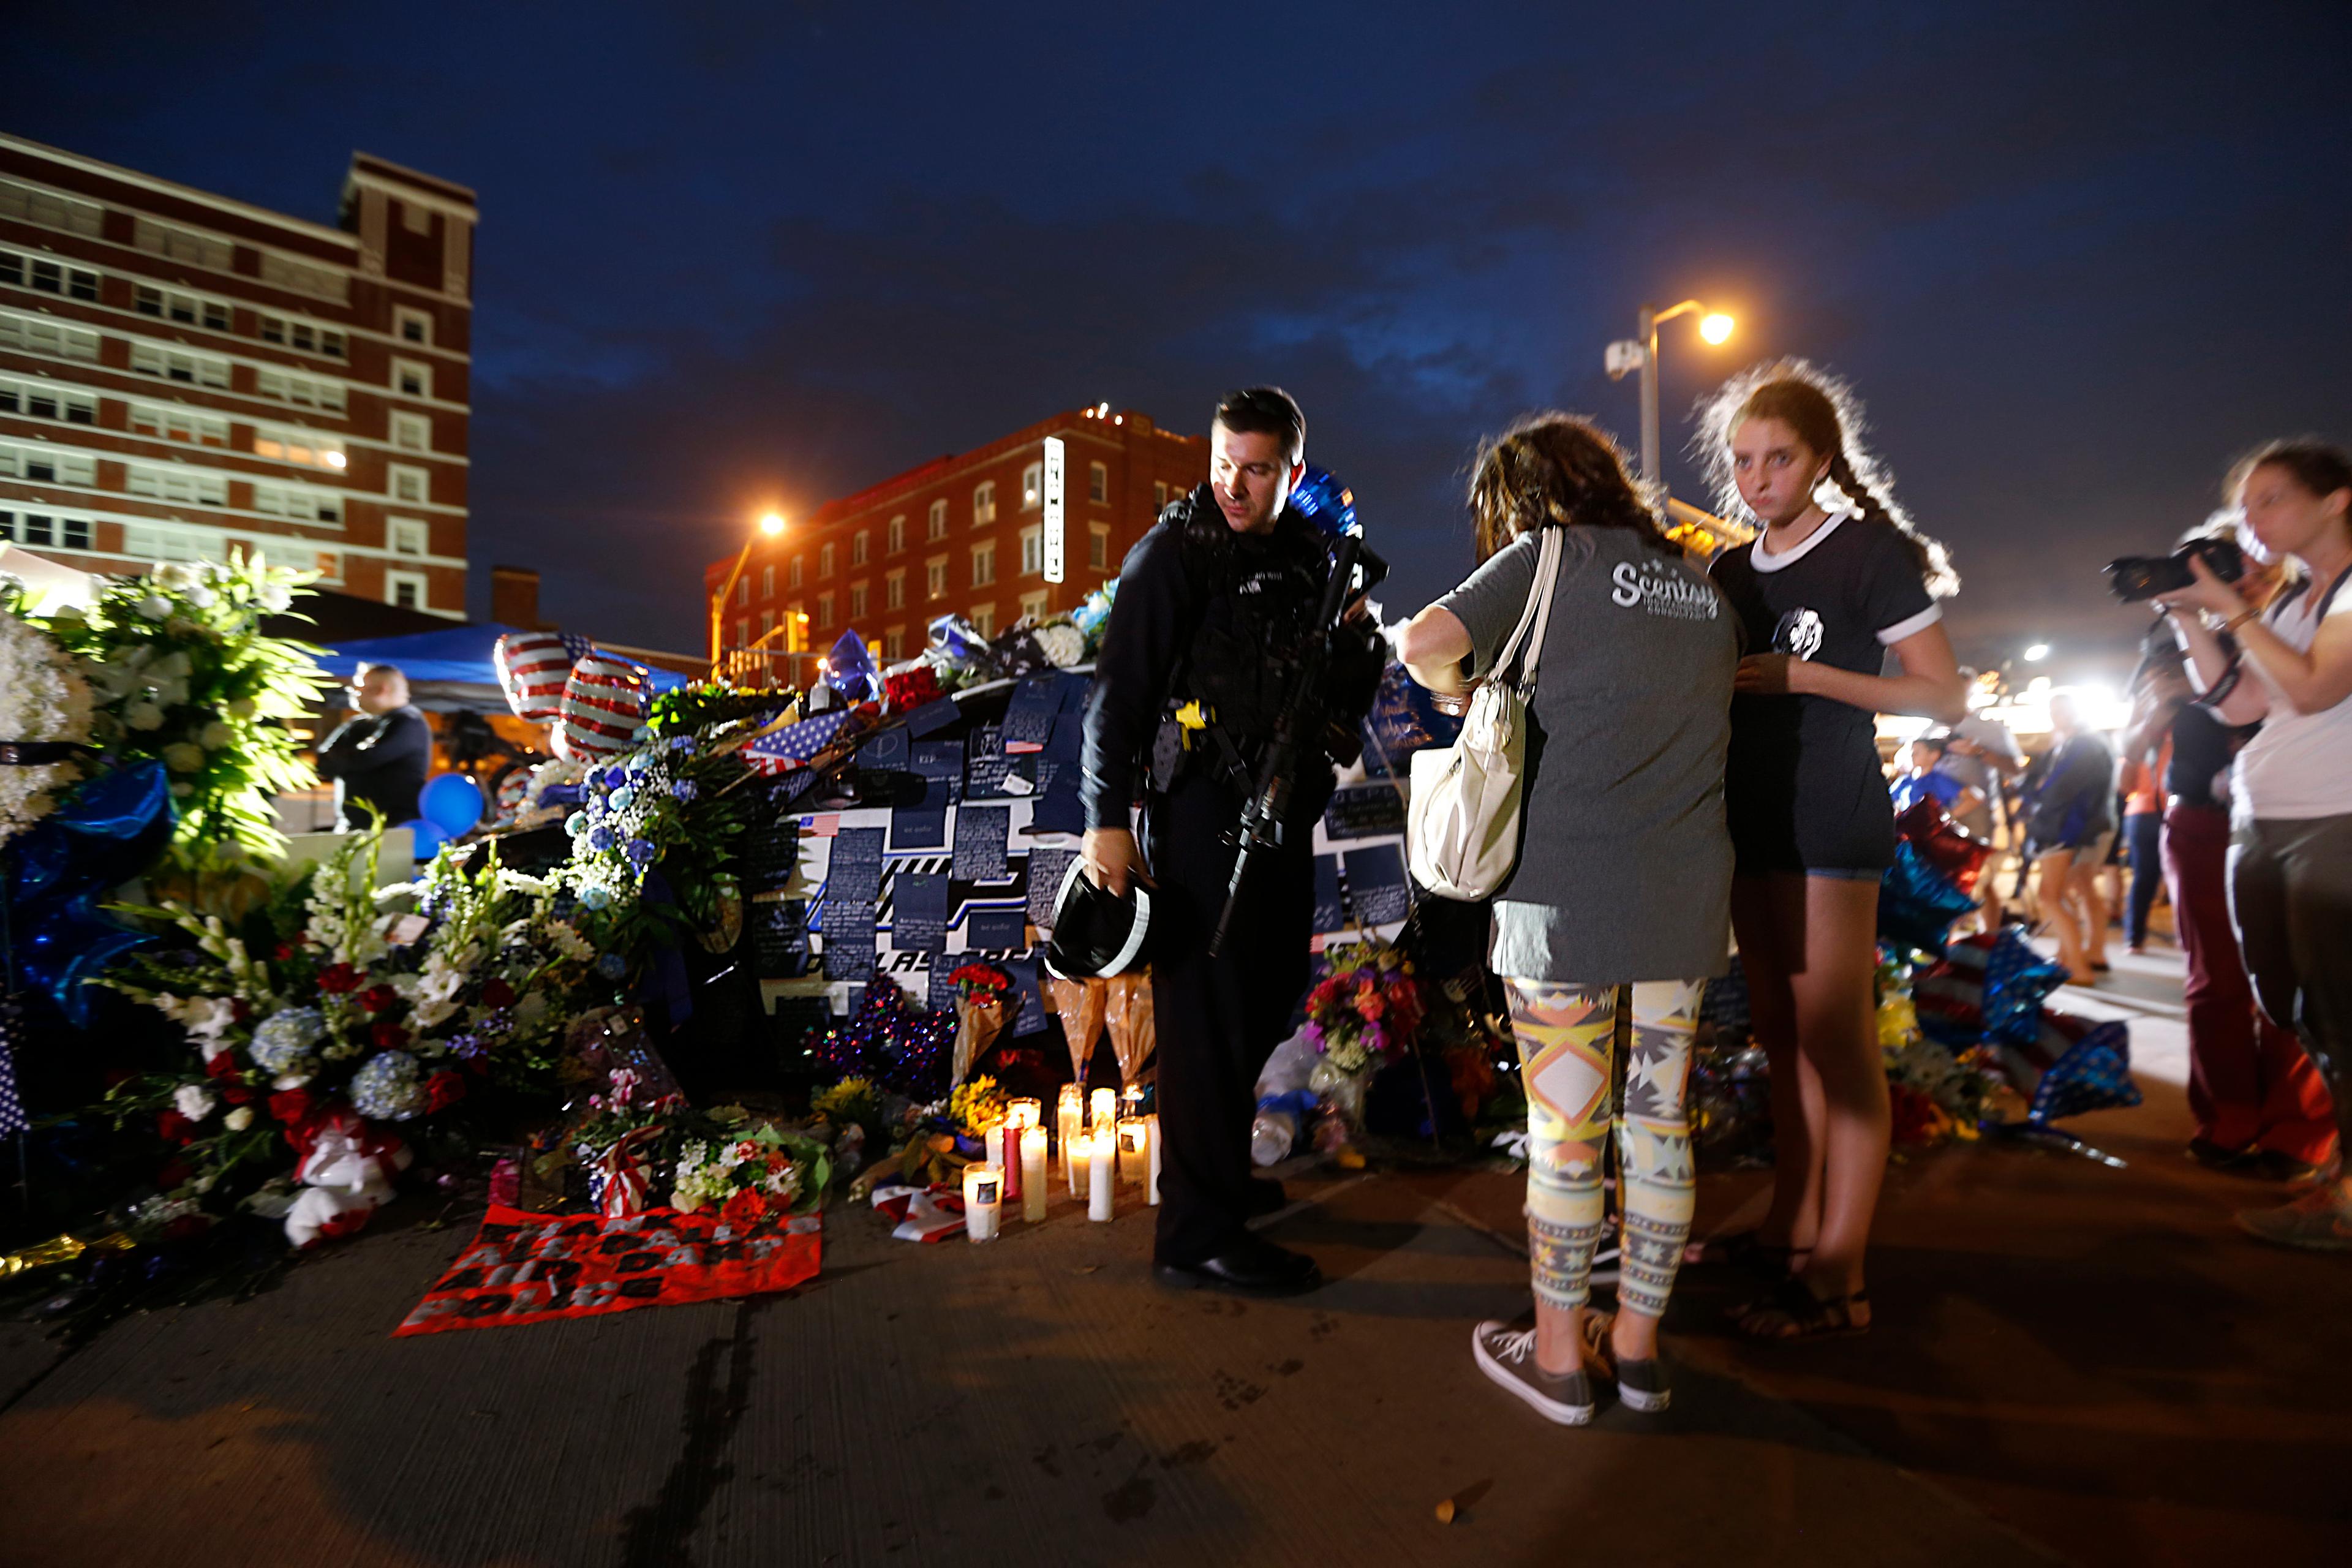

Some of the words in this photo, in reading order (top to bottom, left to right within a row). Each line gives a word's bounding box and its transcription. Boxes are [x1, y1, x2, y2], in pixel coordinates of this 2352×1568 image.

[1611, 560, 1719, 620] Scentsy
[599, 1216, 821, 1256] DALLAS
[614, 1236, 784, 1274] DART
[402, 1275, 665, 1328] POLICE
